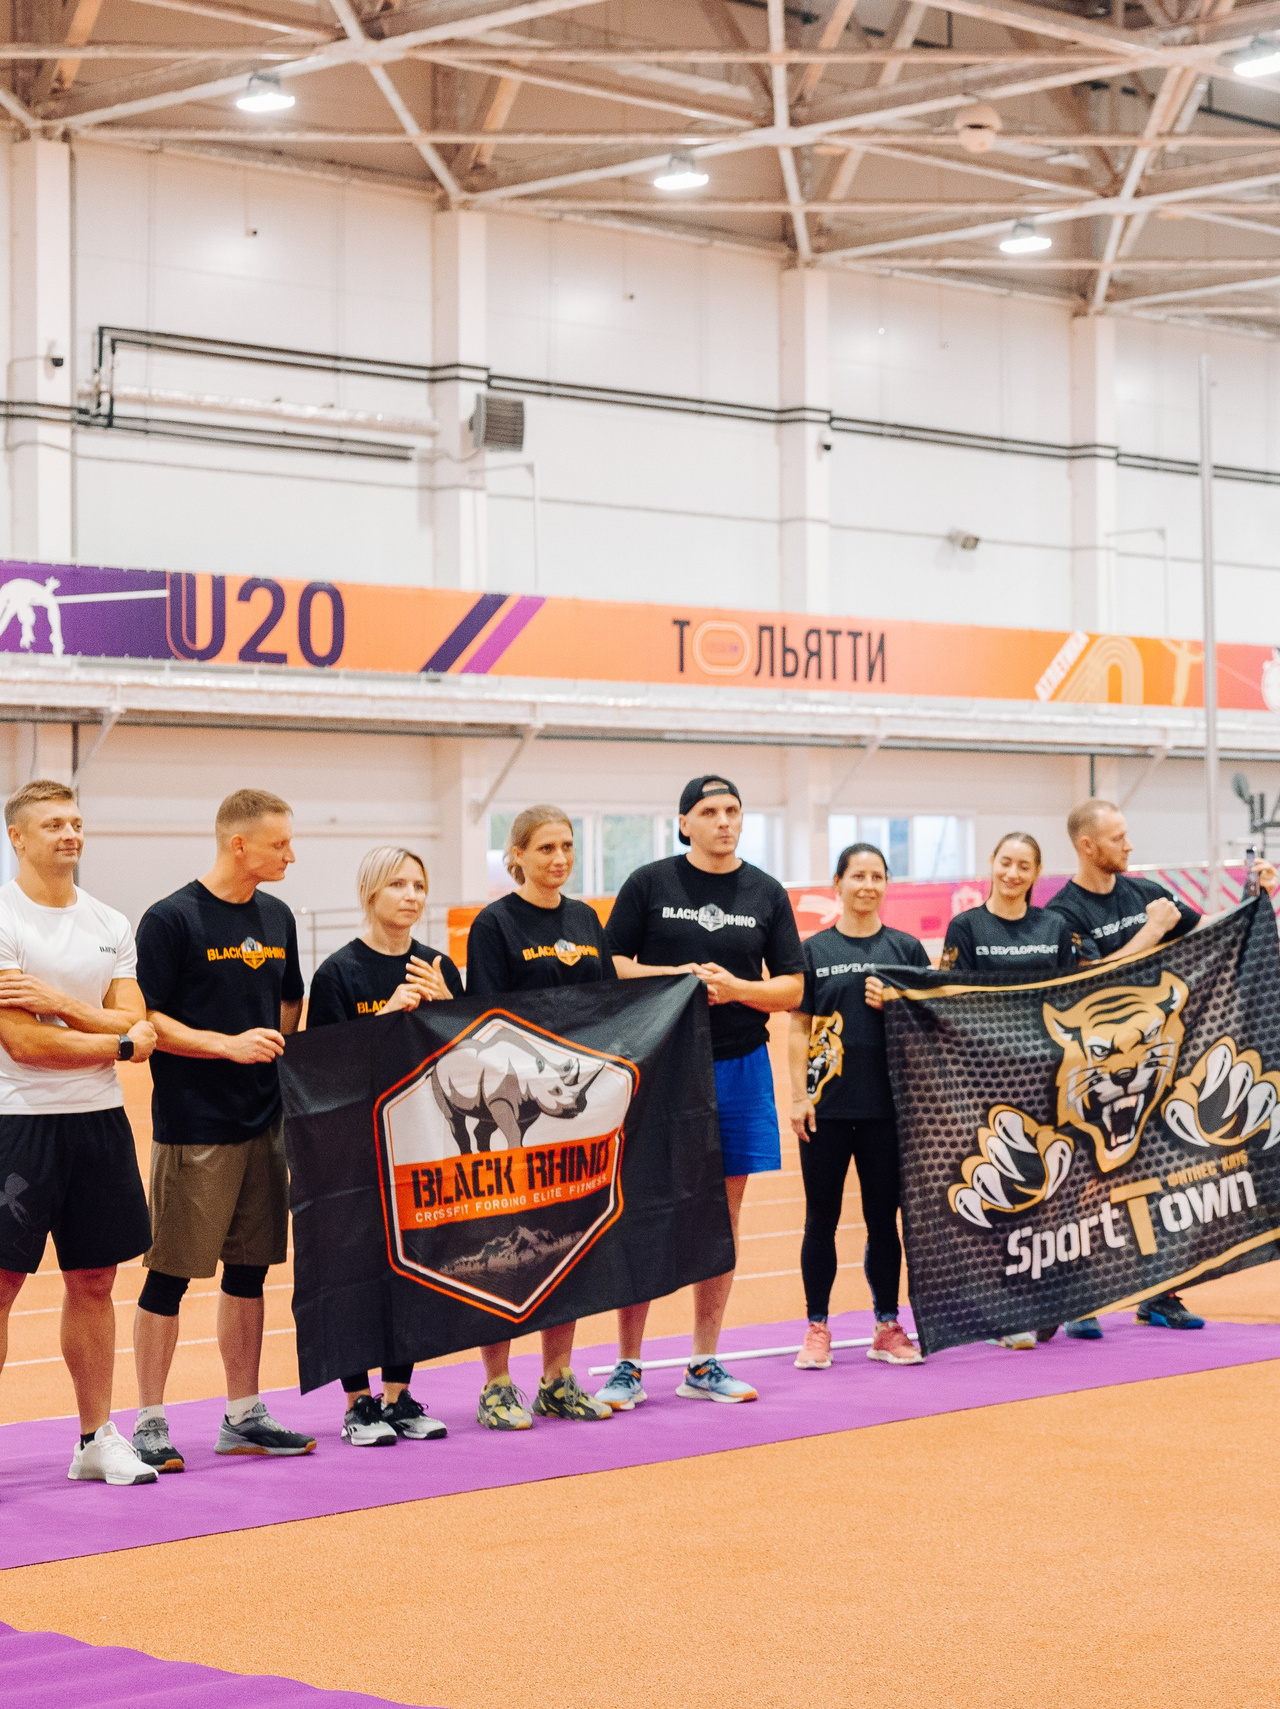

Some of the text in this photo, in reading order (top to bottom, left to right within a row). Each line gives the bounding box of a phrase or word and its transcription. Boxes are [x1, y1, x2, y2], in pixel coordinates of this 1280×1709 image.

[165, 572, 345, 668] U20
[672, 618, 886, 684] ТОЛЬЯТТИ
[662, 906, 756, 928] BLACK RHINO
[207, 946, 242, 961] BLACK
[522, 945, 557, 961] BLACK
[357, 1000, 390, 1014] BLAC
[411, 1136, 612, 1209] BLACK RHINO
[415, 1174, 607, 1223] CROSSFIT FORGING ELITE FITNESS
